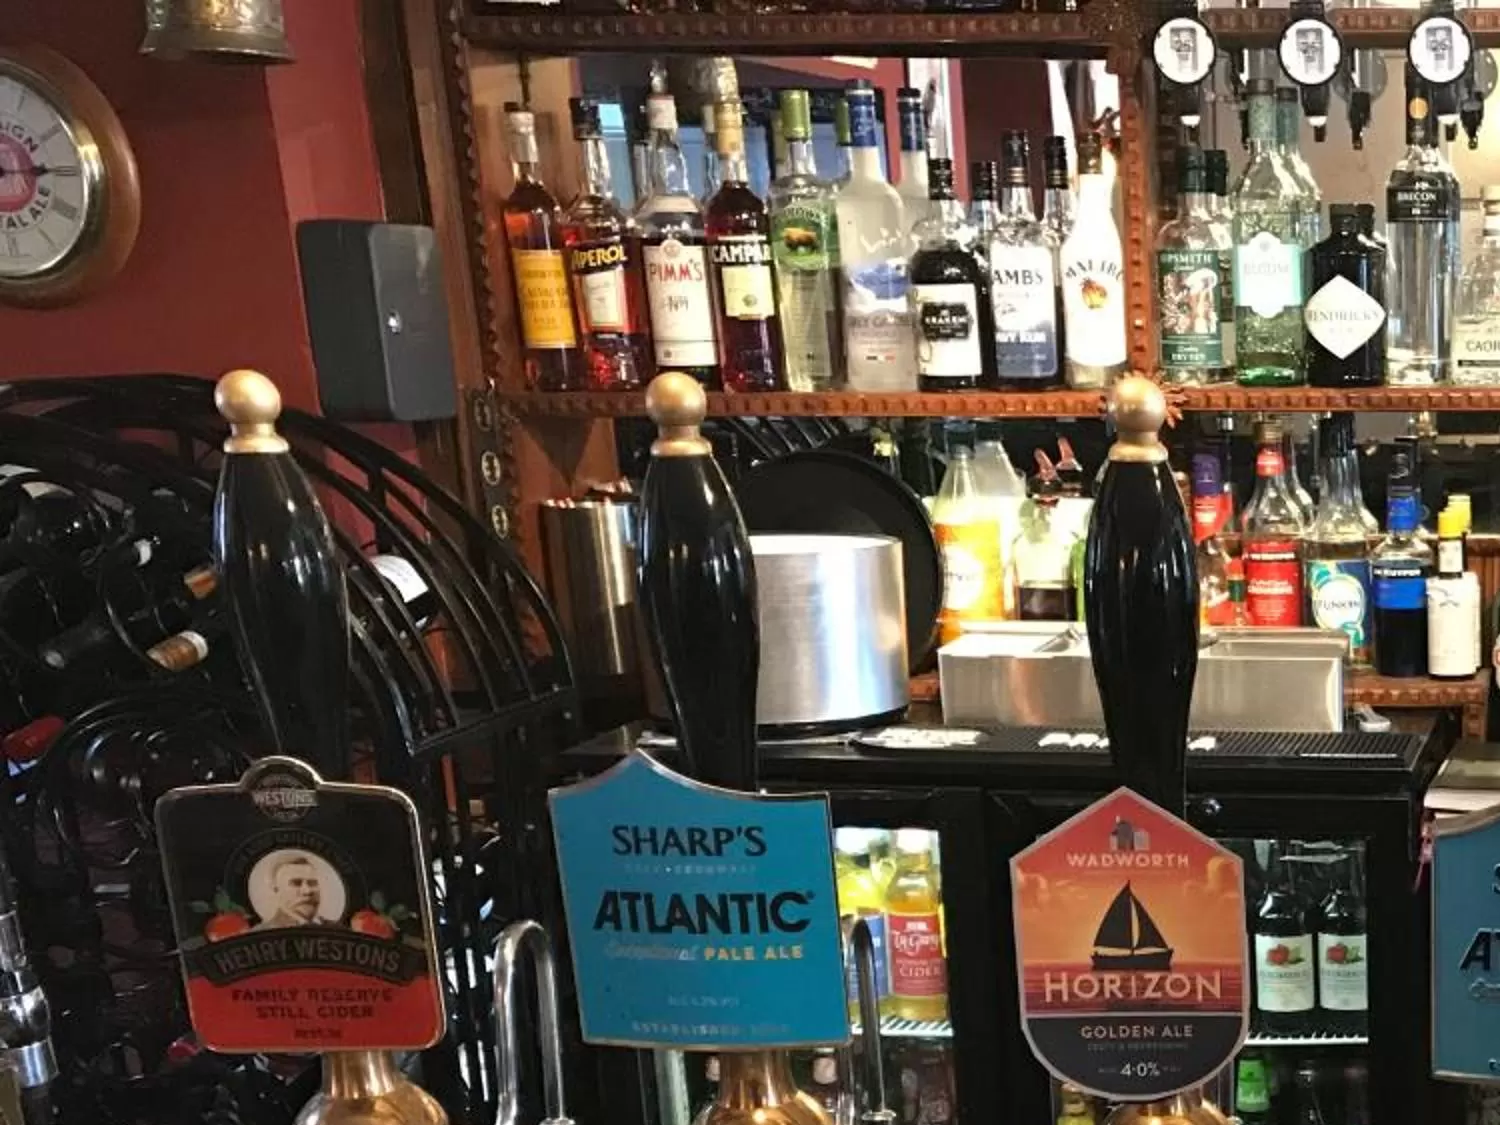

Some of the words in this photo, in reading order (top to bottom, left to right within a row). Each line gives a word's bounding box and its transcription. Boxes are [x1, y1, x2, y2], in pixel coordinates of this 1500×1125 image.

[572, 243, 628, 267] APEROL
[651, 260, 703, 282] PIMM'S
[612, 825, 767, 857] SHARP'S
[1066, 853, 1189, 868] WADWORTH
[593, 890, 812, 935] ATLANTIC
[213, 938, 289, 974] HENRY
[291, 939, 399, 972] WESTONS
[704, 945, 755, 961] PALE
[764, 945, 804, 960] ALE
[231, 988, 299, 1002] FAMILY
[307, 988, 393, 1002] RESERVE
[1044, 972, 1221, 1003] HORIZON
[256, 1006, 309, 1019] STILL
[317, 1006, 374, 1018] CIDER
[1081, 1025, 1155, 1039] GOLDEN
[1161, 1025, 1193, 1038] ALE
